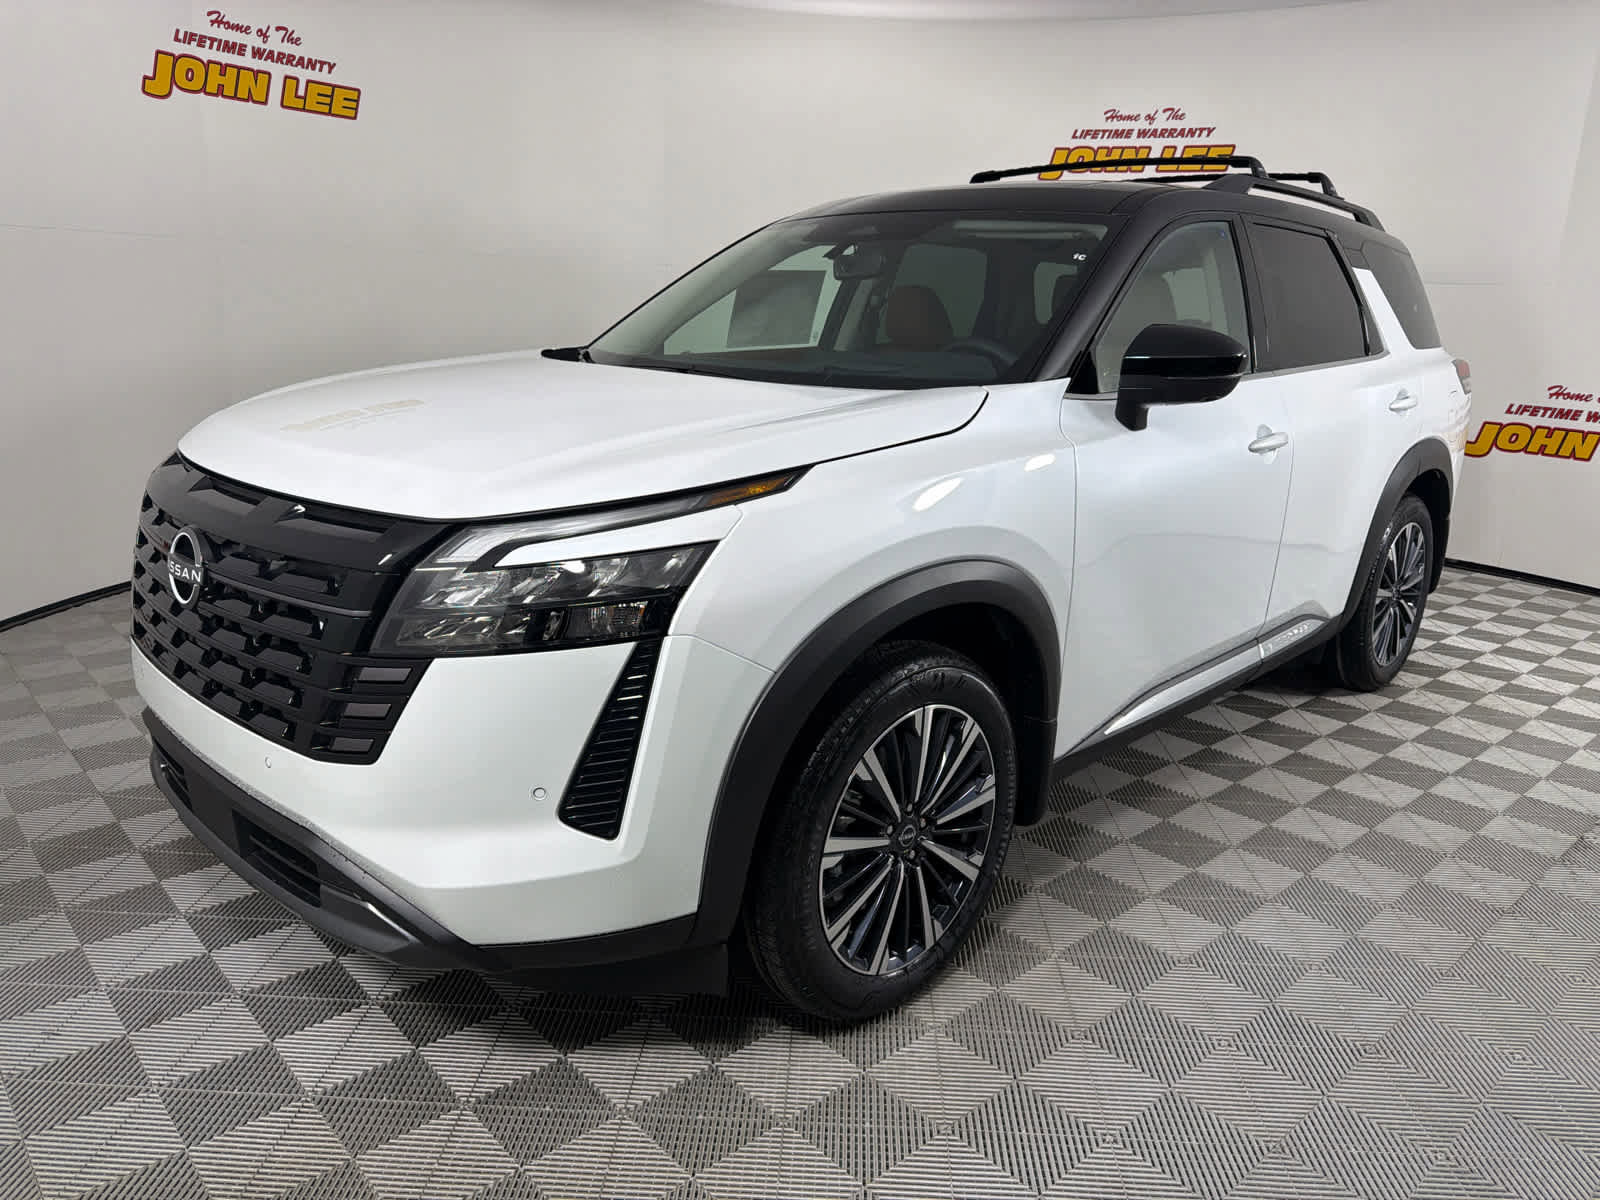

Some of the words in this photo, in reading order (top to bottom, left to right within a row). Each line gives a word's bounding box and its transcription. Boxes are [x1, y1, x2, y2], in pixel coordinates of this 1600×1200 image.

[206, 10, 252, 35] Home
[256, 25, 271, 44] of
[275, 26, 302, 47] The
[173, 28, 248, 57] LIFETIME
[251, 45, 337, 74] WARRANTY
[141, 49, 272, 106] JOHN
[280, 75, 361, 120] LEE
[1071, 128, 1135, 140] LIFETIME
[1136, 127, 1217, 139] WARRANTY
[1104, 108, 1141, 123] Home
[1144, 110, 1158, 125] of
[1162, 107, 1186, 121] The
[1038, 145, 1152, 181] JOHN
[1155, 144, 1236, 173] LEE
[1504, 403, 1584, 421] LIFETIME
[1547, 385, 1593, 402] Home
[1464, 421, 1600, 462] JOHN
